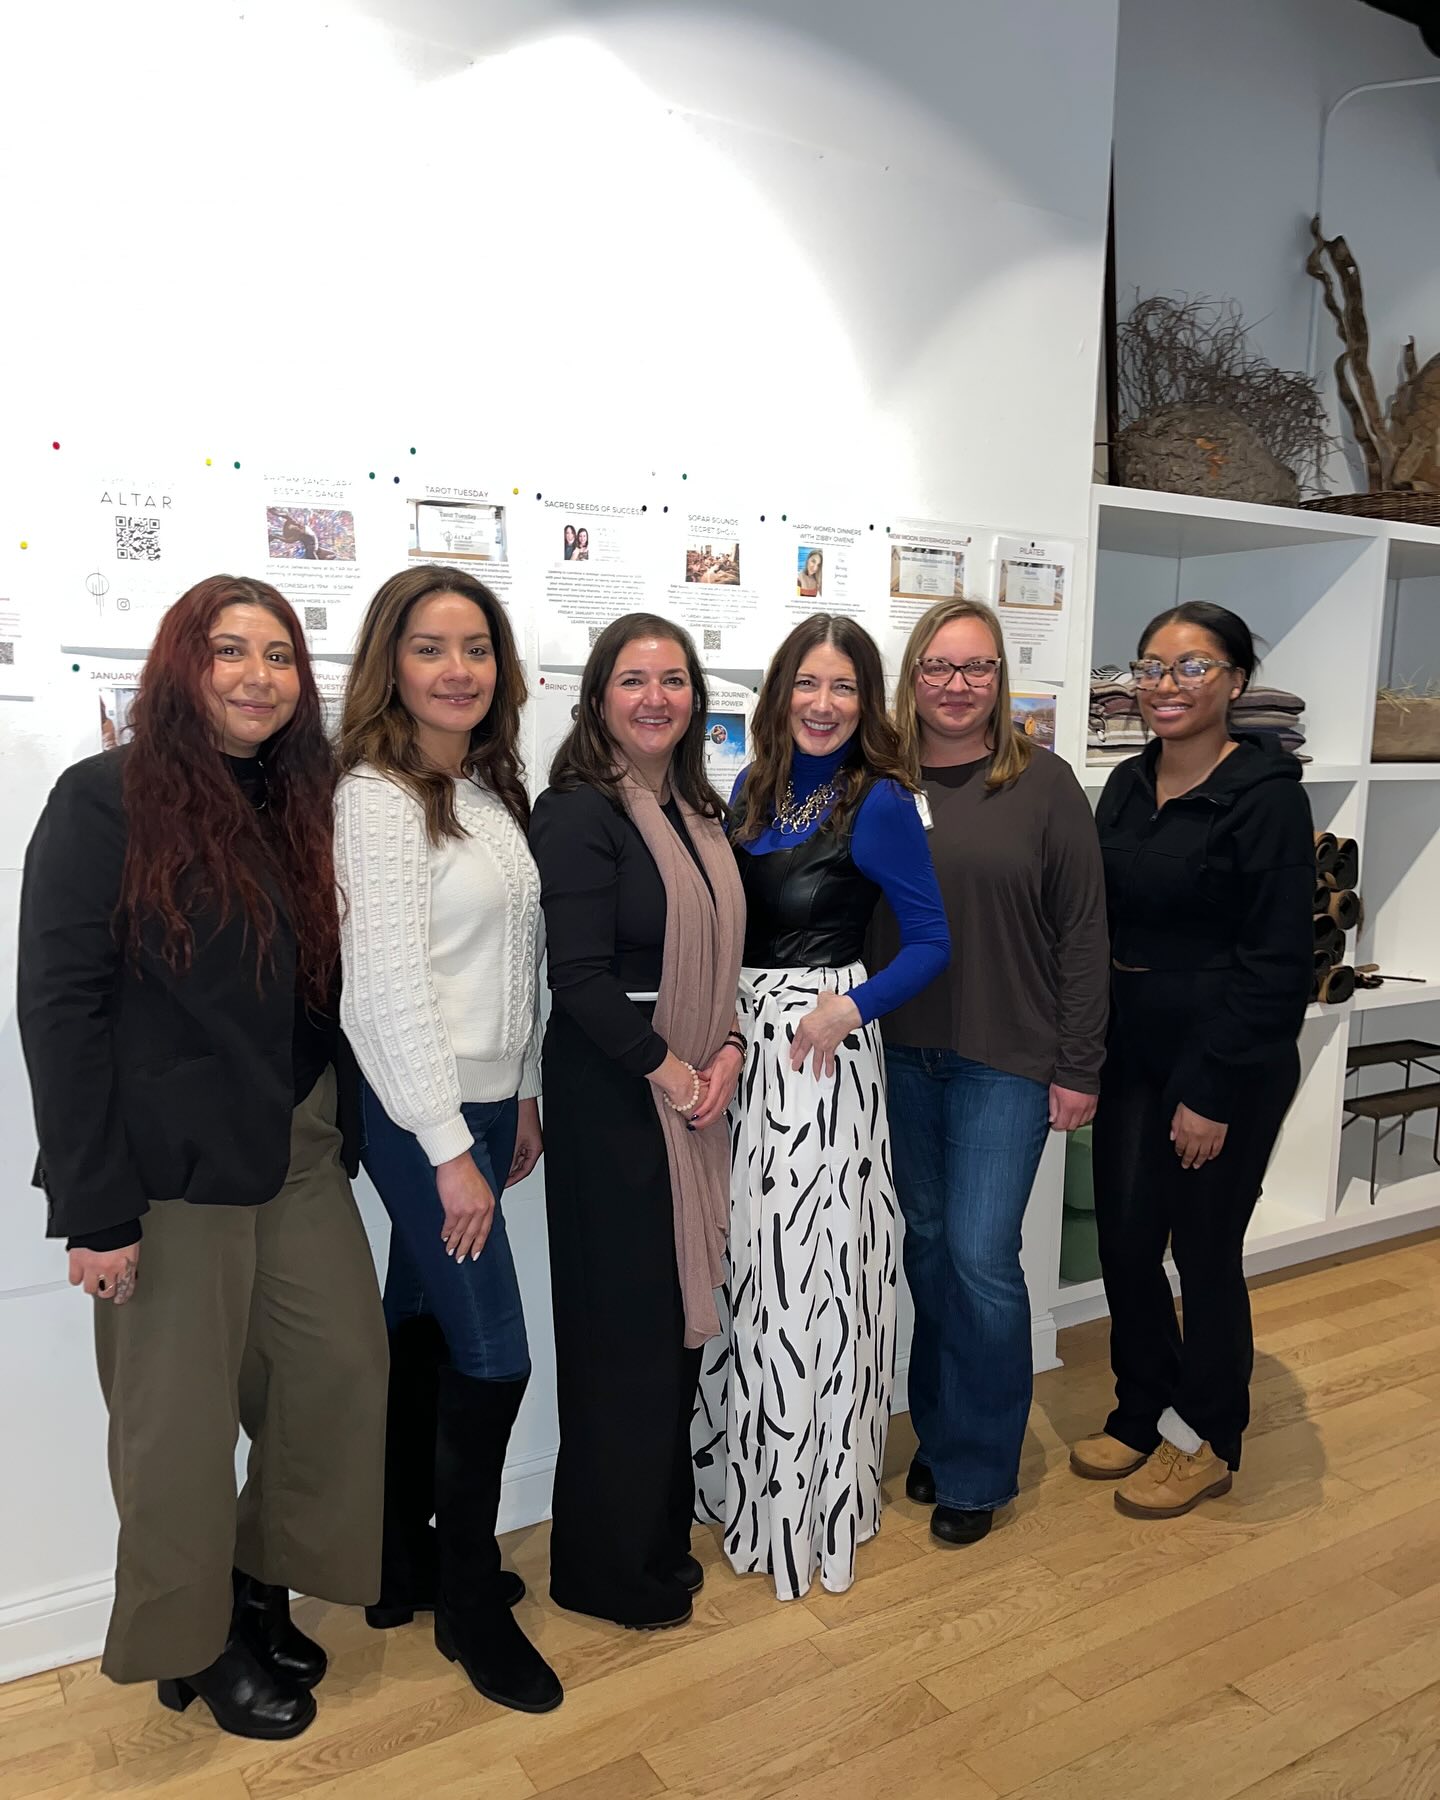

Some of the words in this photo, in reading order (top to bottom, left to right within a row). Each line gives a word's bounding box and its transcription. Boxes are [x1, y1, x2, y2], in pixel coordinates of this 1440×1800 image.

[425, 486, 451, 495] TAROT
[453, 488, 489, 498] TUESDAY
[100, 491, 172, 509] ALTAR
[544, 500, 575, 510] SACRED
[576, 502, 600, 512] SEEDS
[600, 505, 611, 513] OF
[688, 514, 710, 522] SOFAR
[711, 517, 739, 526] SOUNDS
[813, 525, 836, 534] WOMEN
[836, 527, 862, 536] DINNERS
[815, 534, 832, 542] ZIBBY
[833, 536, 855, 544] OWENS
[919, 536, 951, 545] SISTERHOOD
[1019, 547, 1045, 557] PILATES
[90, 671, 139, 680] JANUARY
[721, 691, 750, 699] JOURNEY
